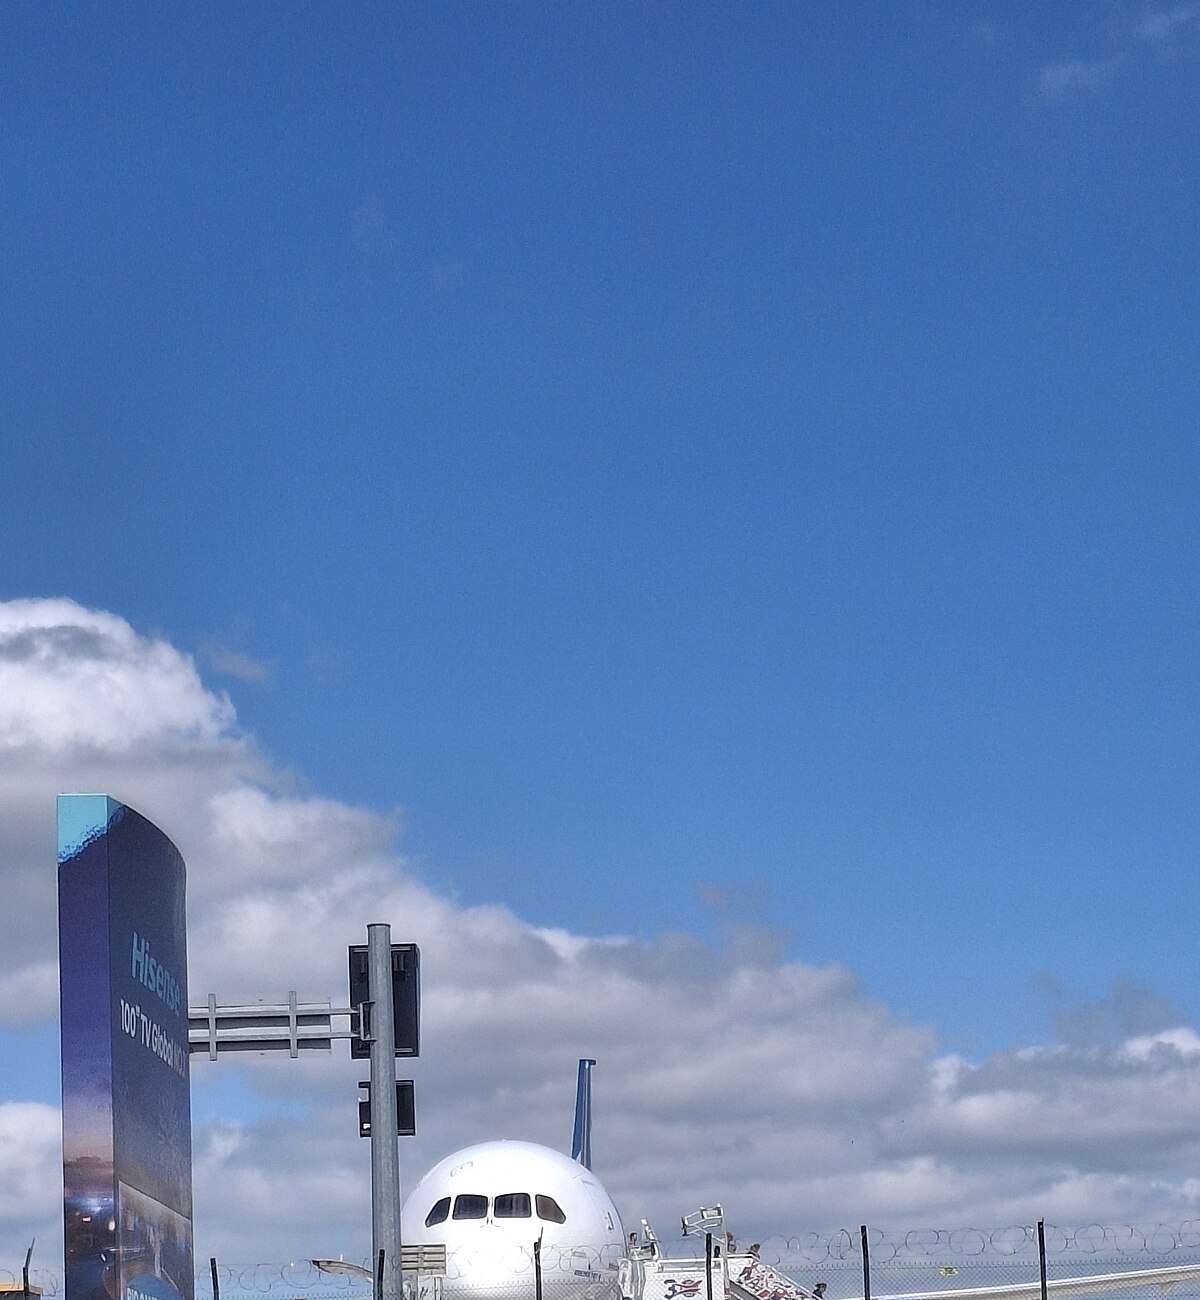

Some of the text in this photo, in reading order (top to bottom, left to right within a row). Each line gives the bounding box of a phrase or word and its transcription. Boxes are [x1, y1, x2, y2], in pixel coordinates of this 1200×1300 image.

[131, 932, 182, 1016] Hisense
[141, 1013, 153, 1048] TV
[152, 1023, 174, 1068] Global
